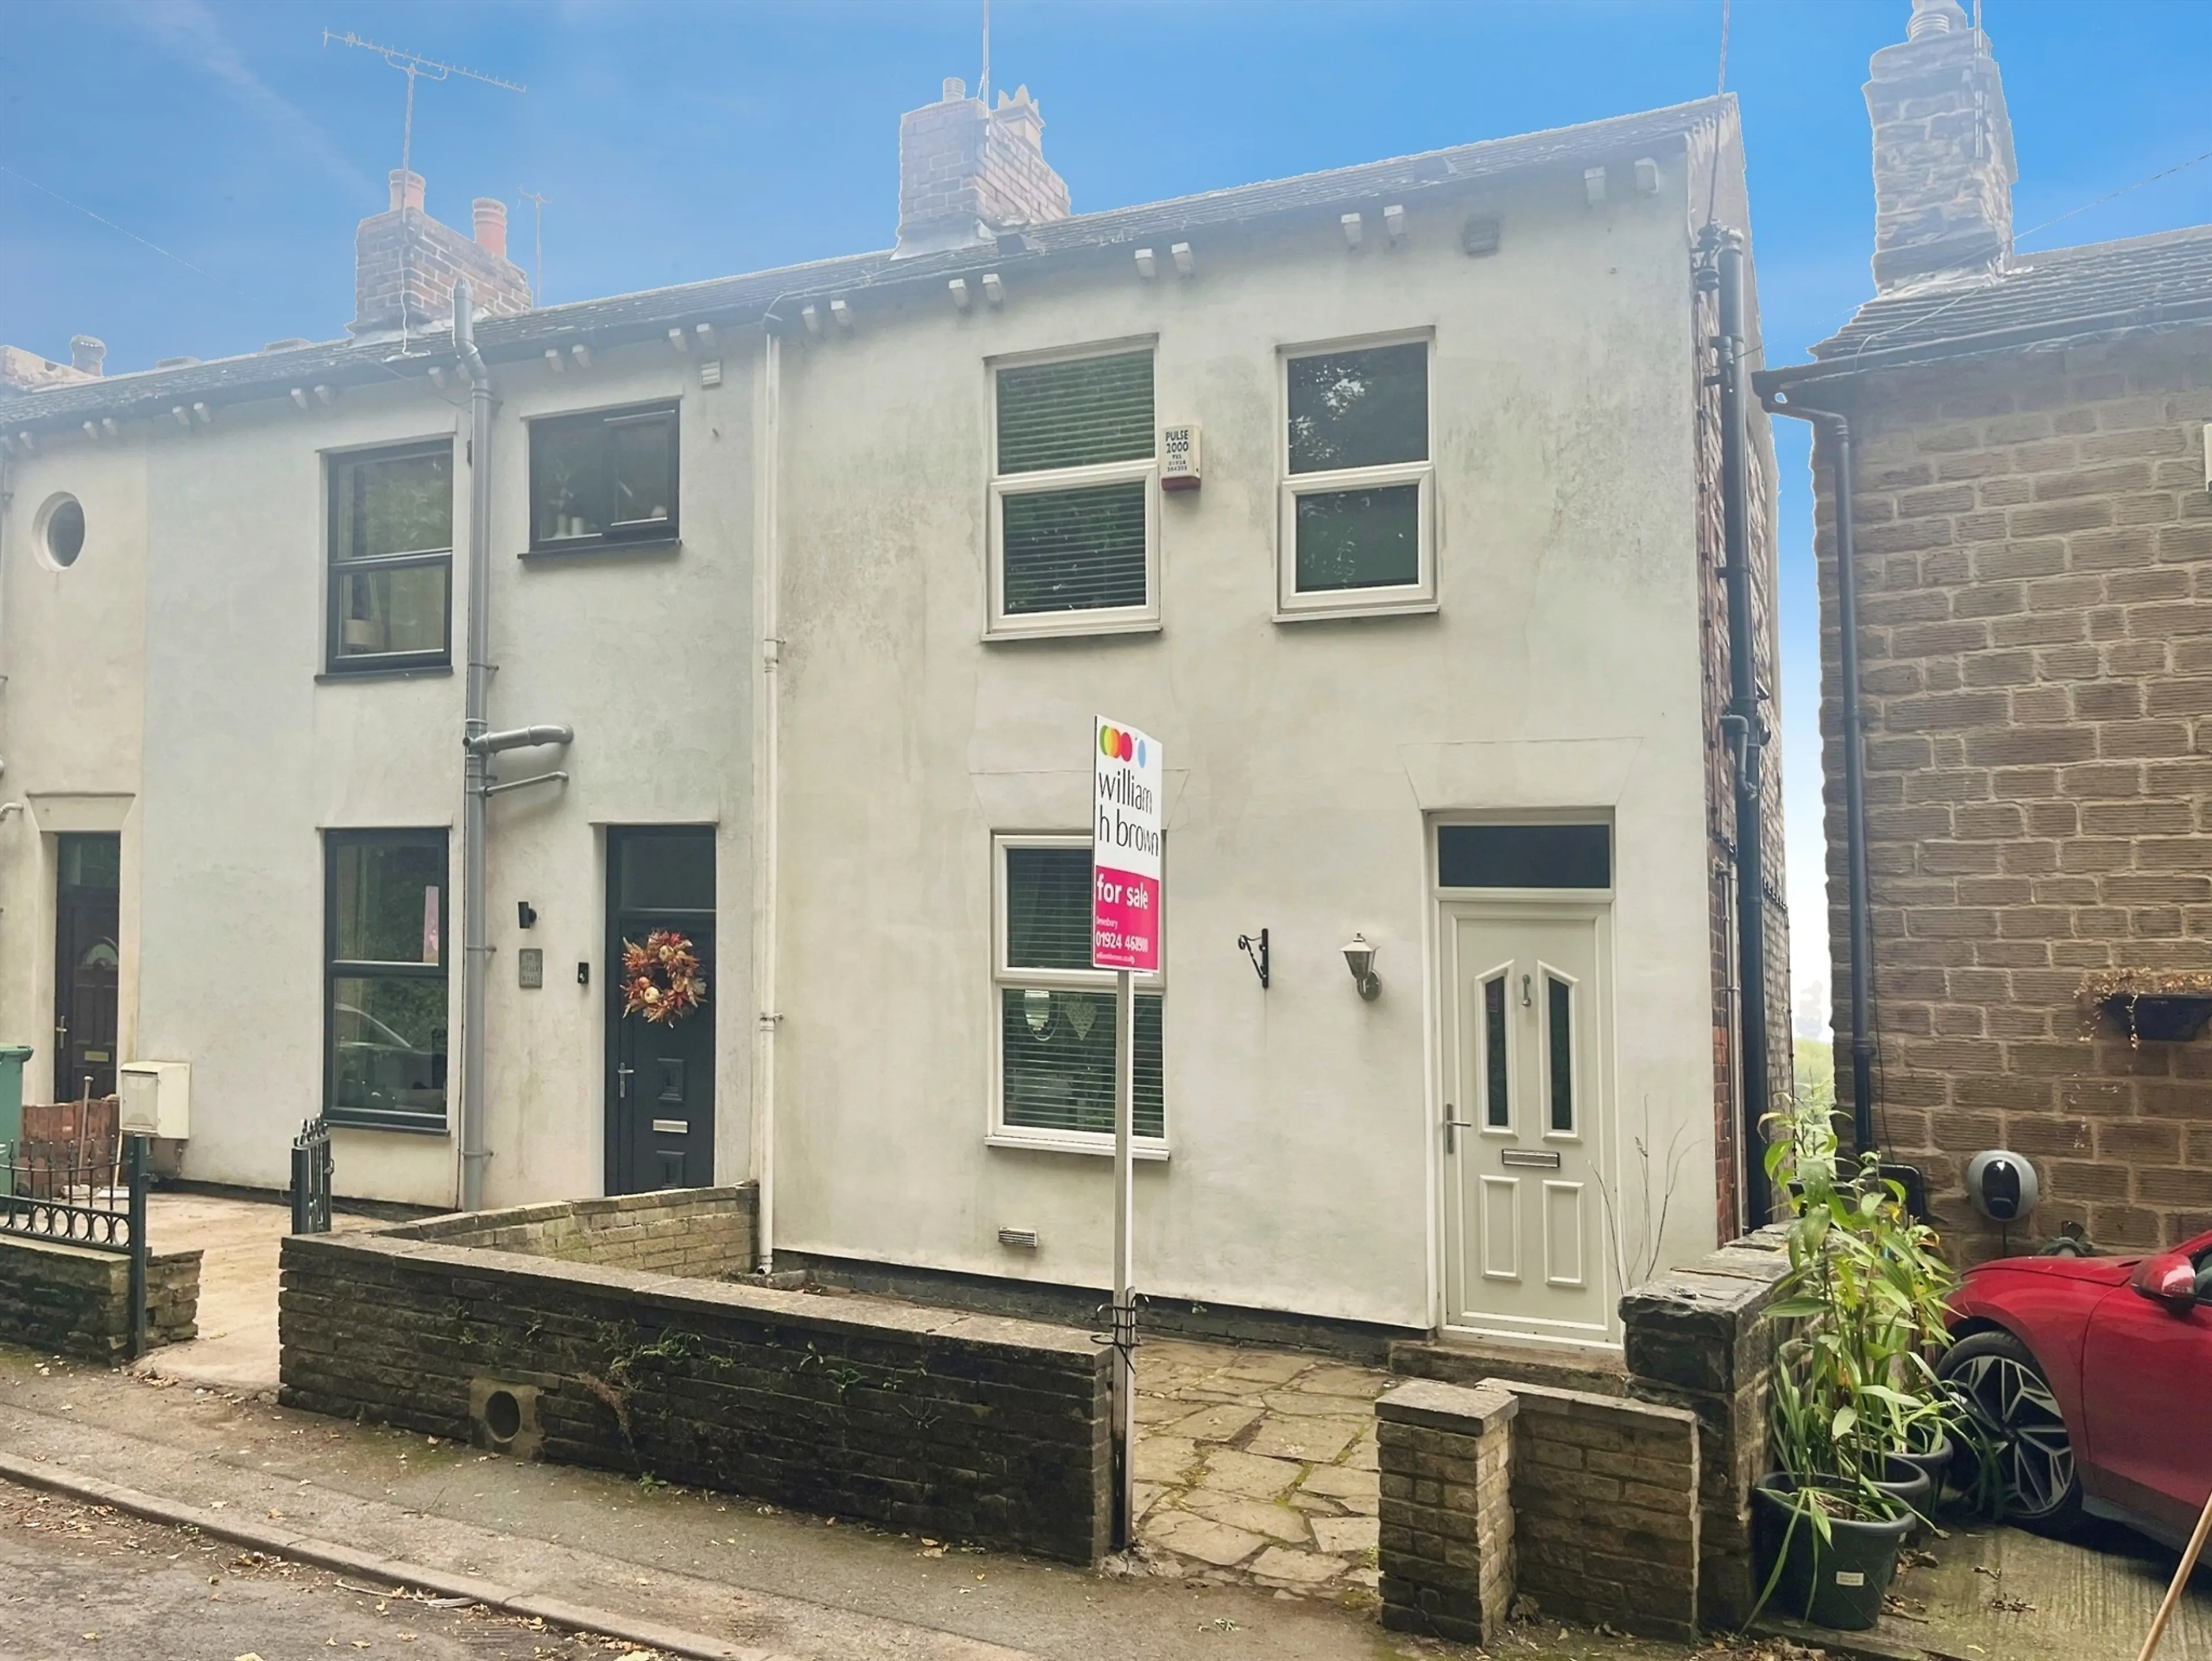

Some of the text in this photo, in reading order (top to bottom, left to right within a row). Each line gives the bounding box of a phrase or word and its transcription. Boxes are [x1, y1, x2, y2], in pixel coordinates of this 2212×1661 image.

[1165, 430, 1188, 441] PULSE
[1166, 441, 1188, 453] 2000
[1099, 768, 1152, 814] william
[1100, 804, 1158, 857] h brown
[1097, 873, 1148, 910] for sale
[1096, 930, 1122, 949] 01924
